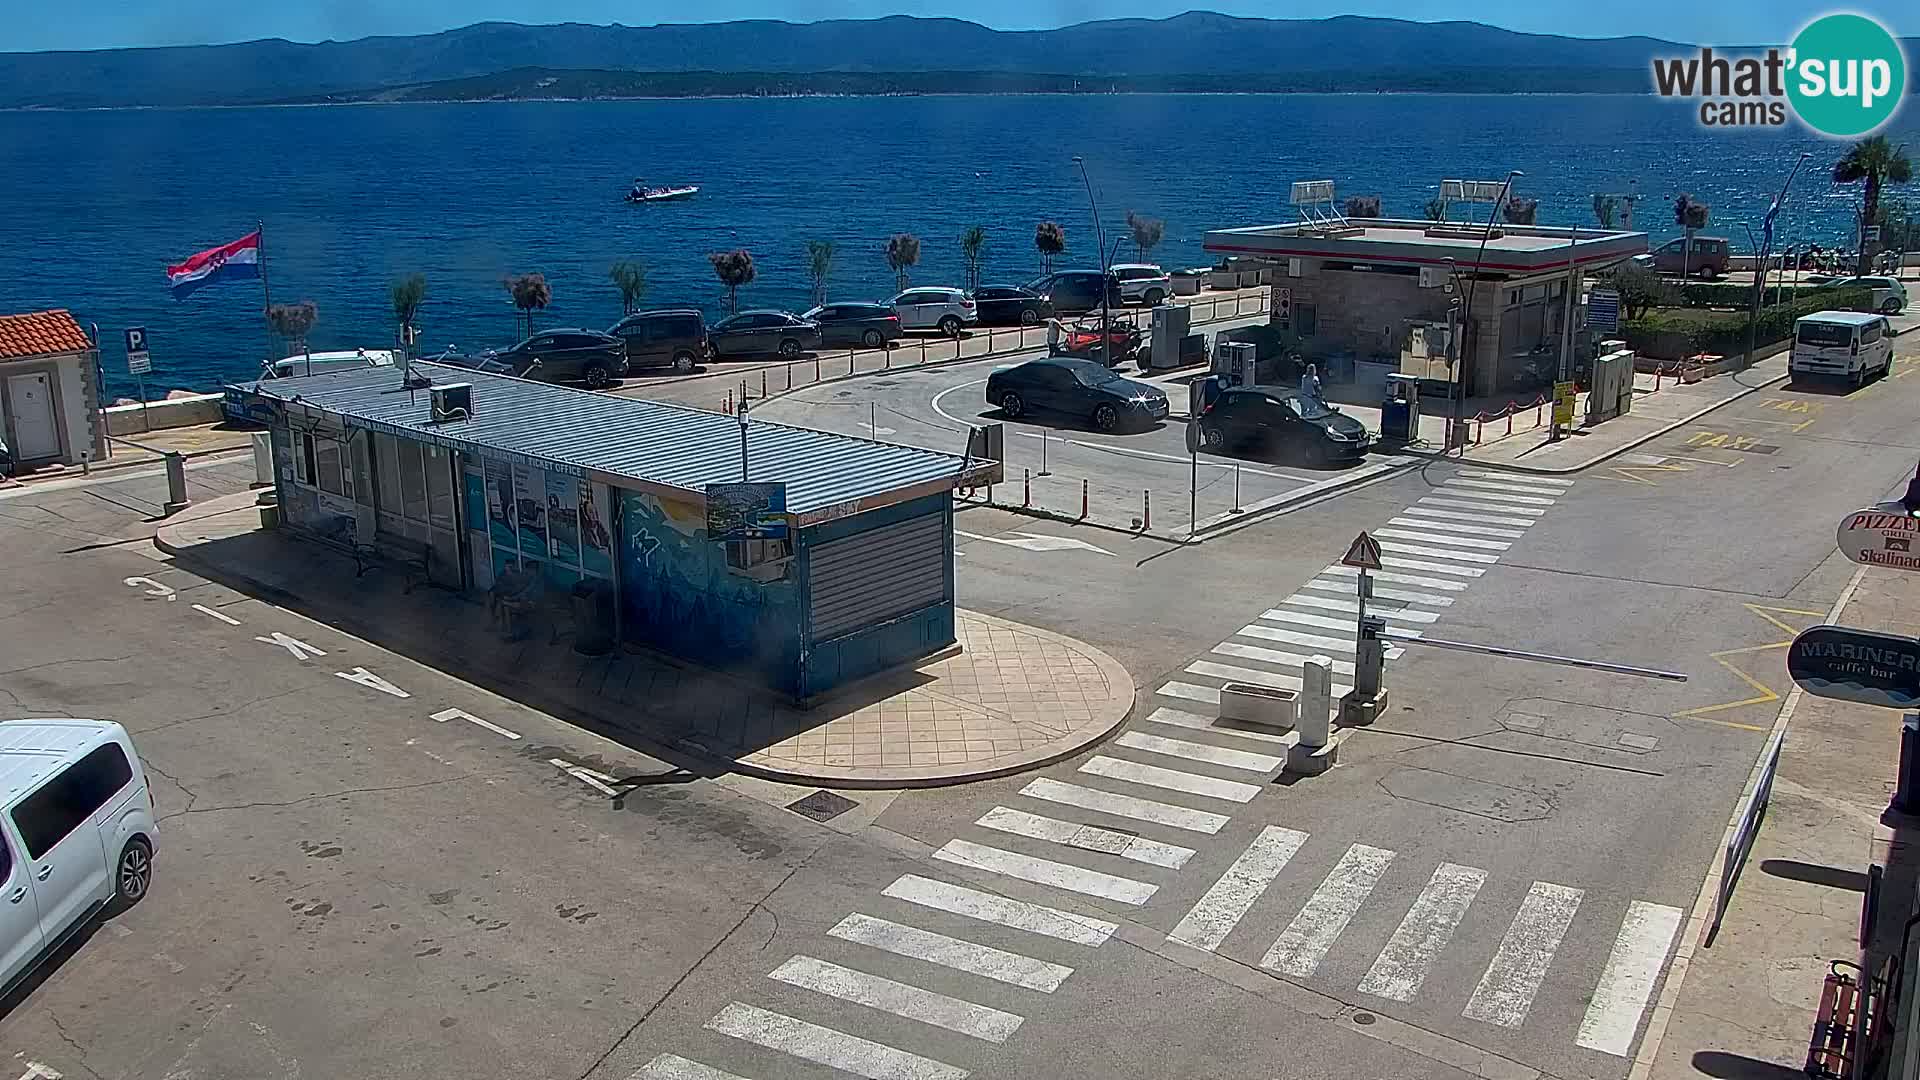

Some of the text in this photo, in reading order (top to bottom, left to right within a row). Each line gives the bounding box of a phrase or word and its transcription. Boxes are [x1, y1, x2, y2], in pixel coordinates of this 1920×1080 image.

[130, 331, 142, 350] P
[1687, 431, 1763, 450] TAXI
[528, 457, 554, 471] TICKET
[555, 463, 582, 477] OFFICE
[1848, 515, 1920, 532] PIZZE
[1828, 662, 1897, 680] caffe bar
